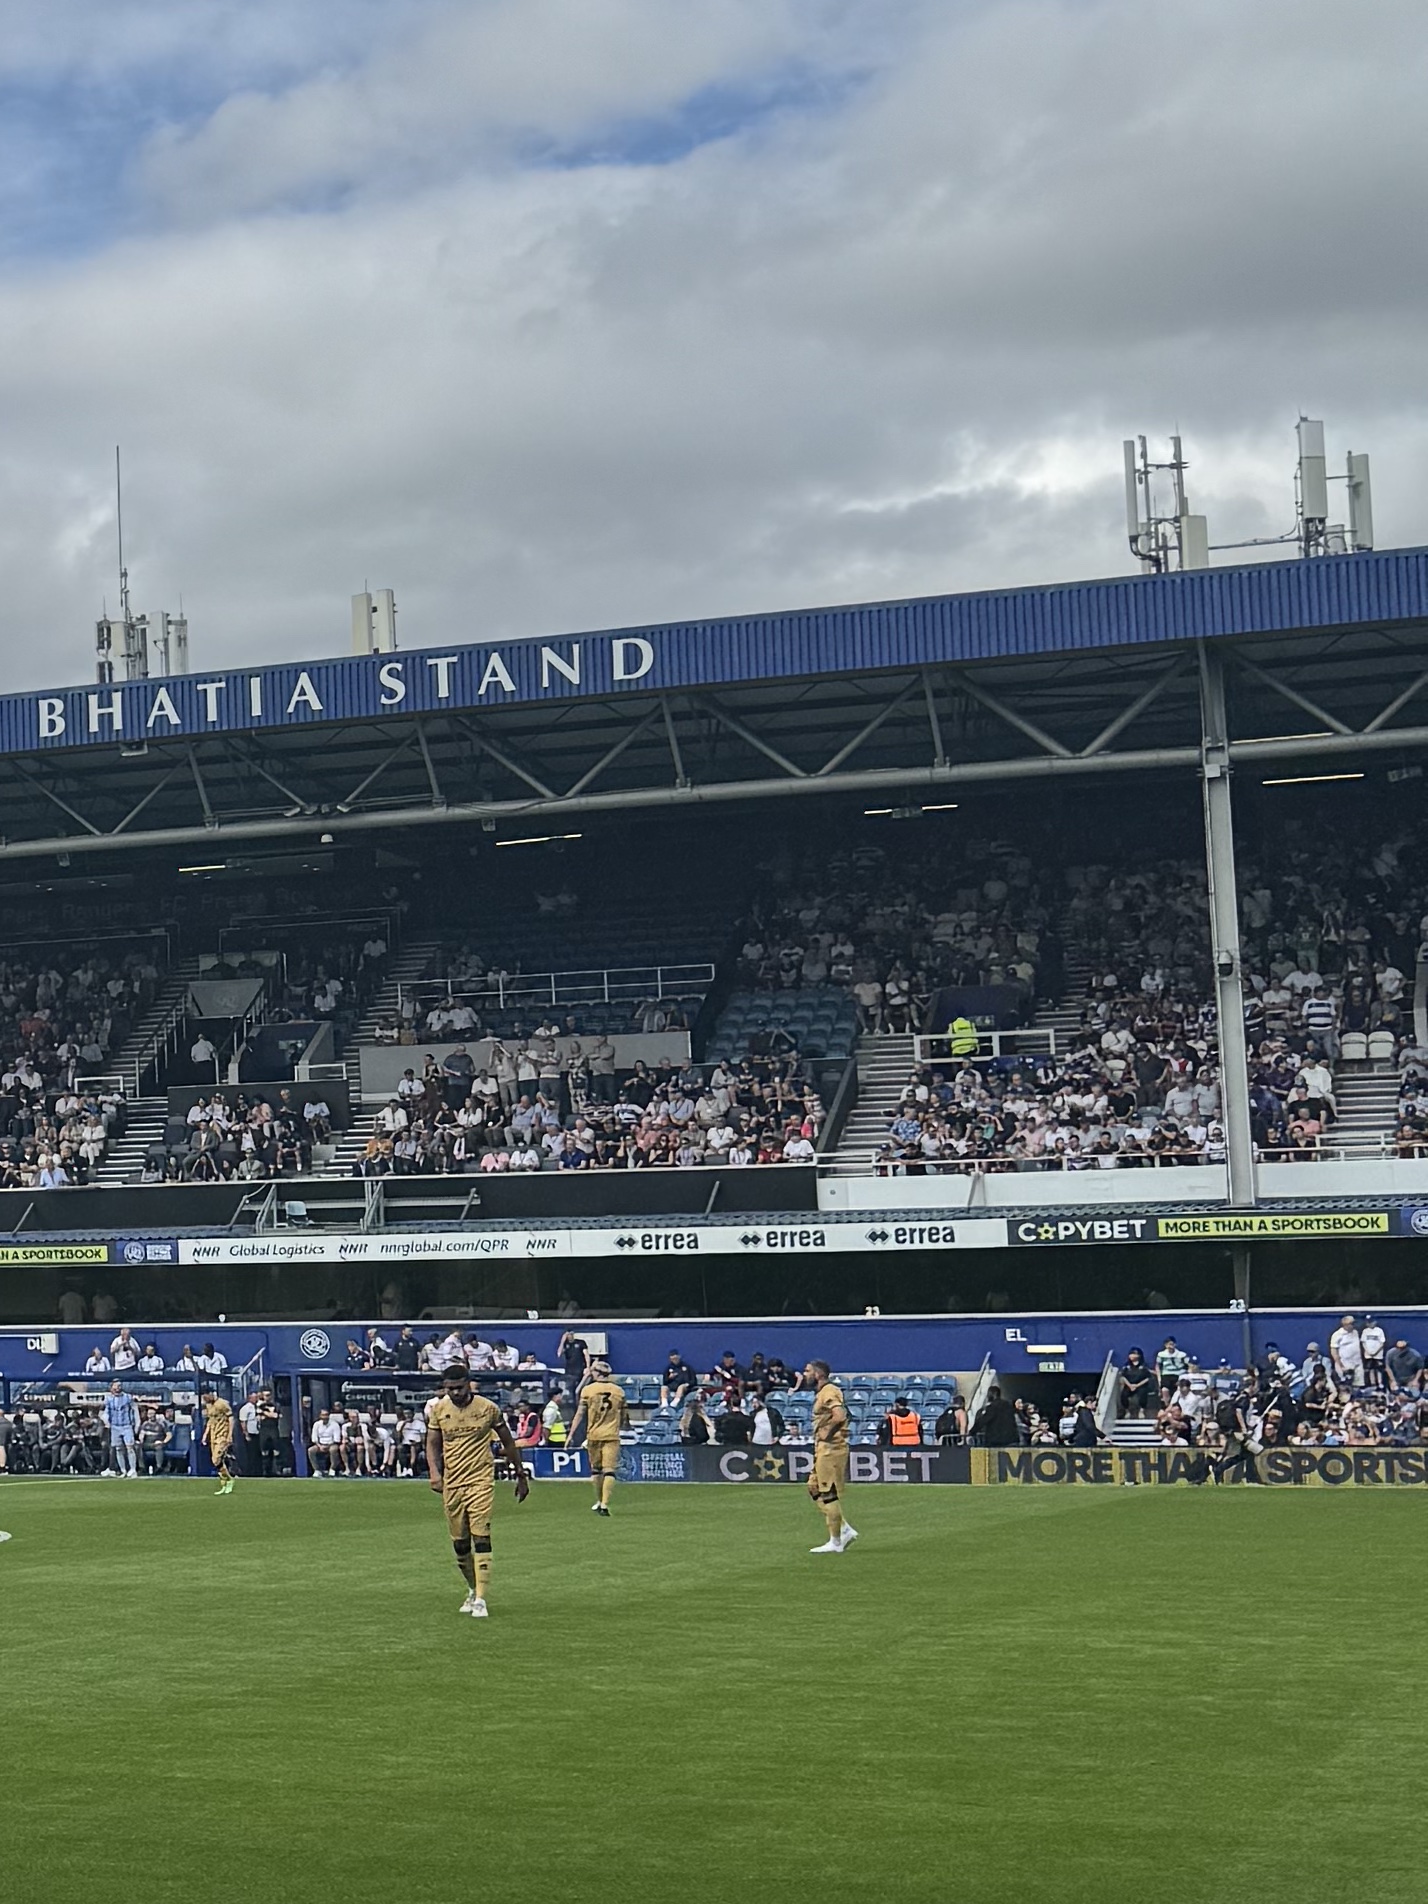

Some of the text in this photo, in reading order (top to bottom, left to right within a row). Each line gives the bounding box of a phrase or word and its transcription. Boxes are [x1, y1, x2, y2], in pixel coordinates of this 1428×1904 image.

[38, 671, 324, 738] BHATIA
[378, 637, 655, 706] STAND
[1164, 1216, 1382, 1234] MORE THAN A SPORTSBOOK
[11, 1250, 20, 1260] A
[229, 1243, 271, 1256] Global
[272, 1242, 325, 1258] Logistics
[1005, 1328, 1028, 1342] EL
[596, 1391, 613, 1412] 3
[552, 1451, 581, 1473] P1
[997, 1451, 1115, 1484] MORE
[1118, 1451, 1208, 1485] THA
[1266, 1451, 1428, 1485] SPORTS
